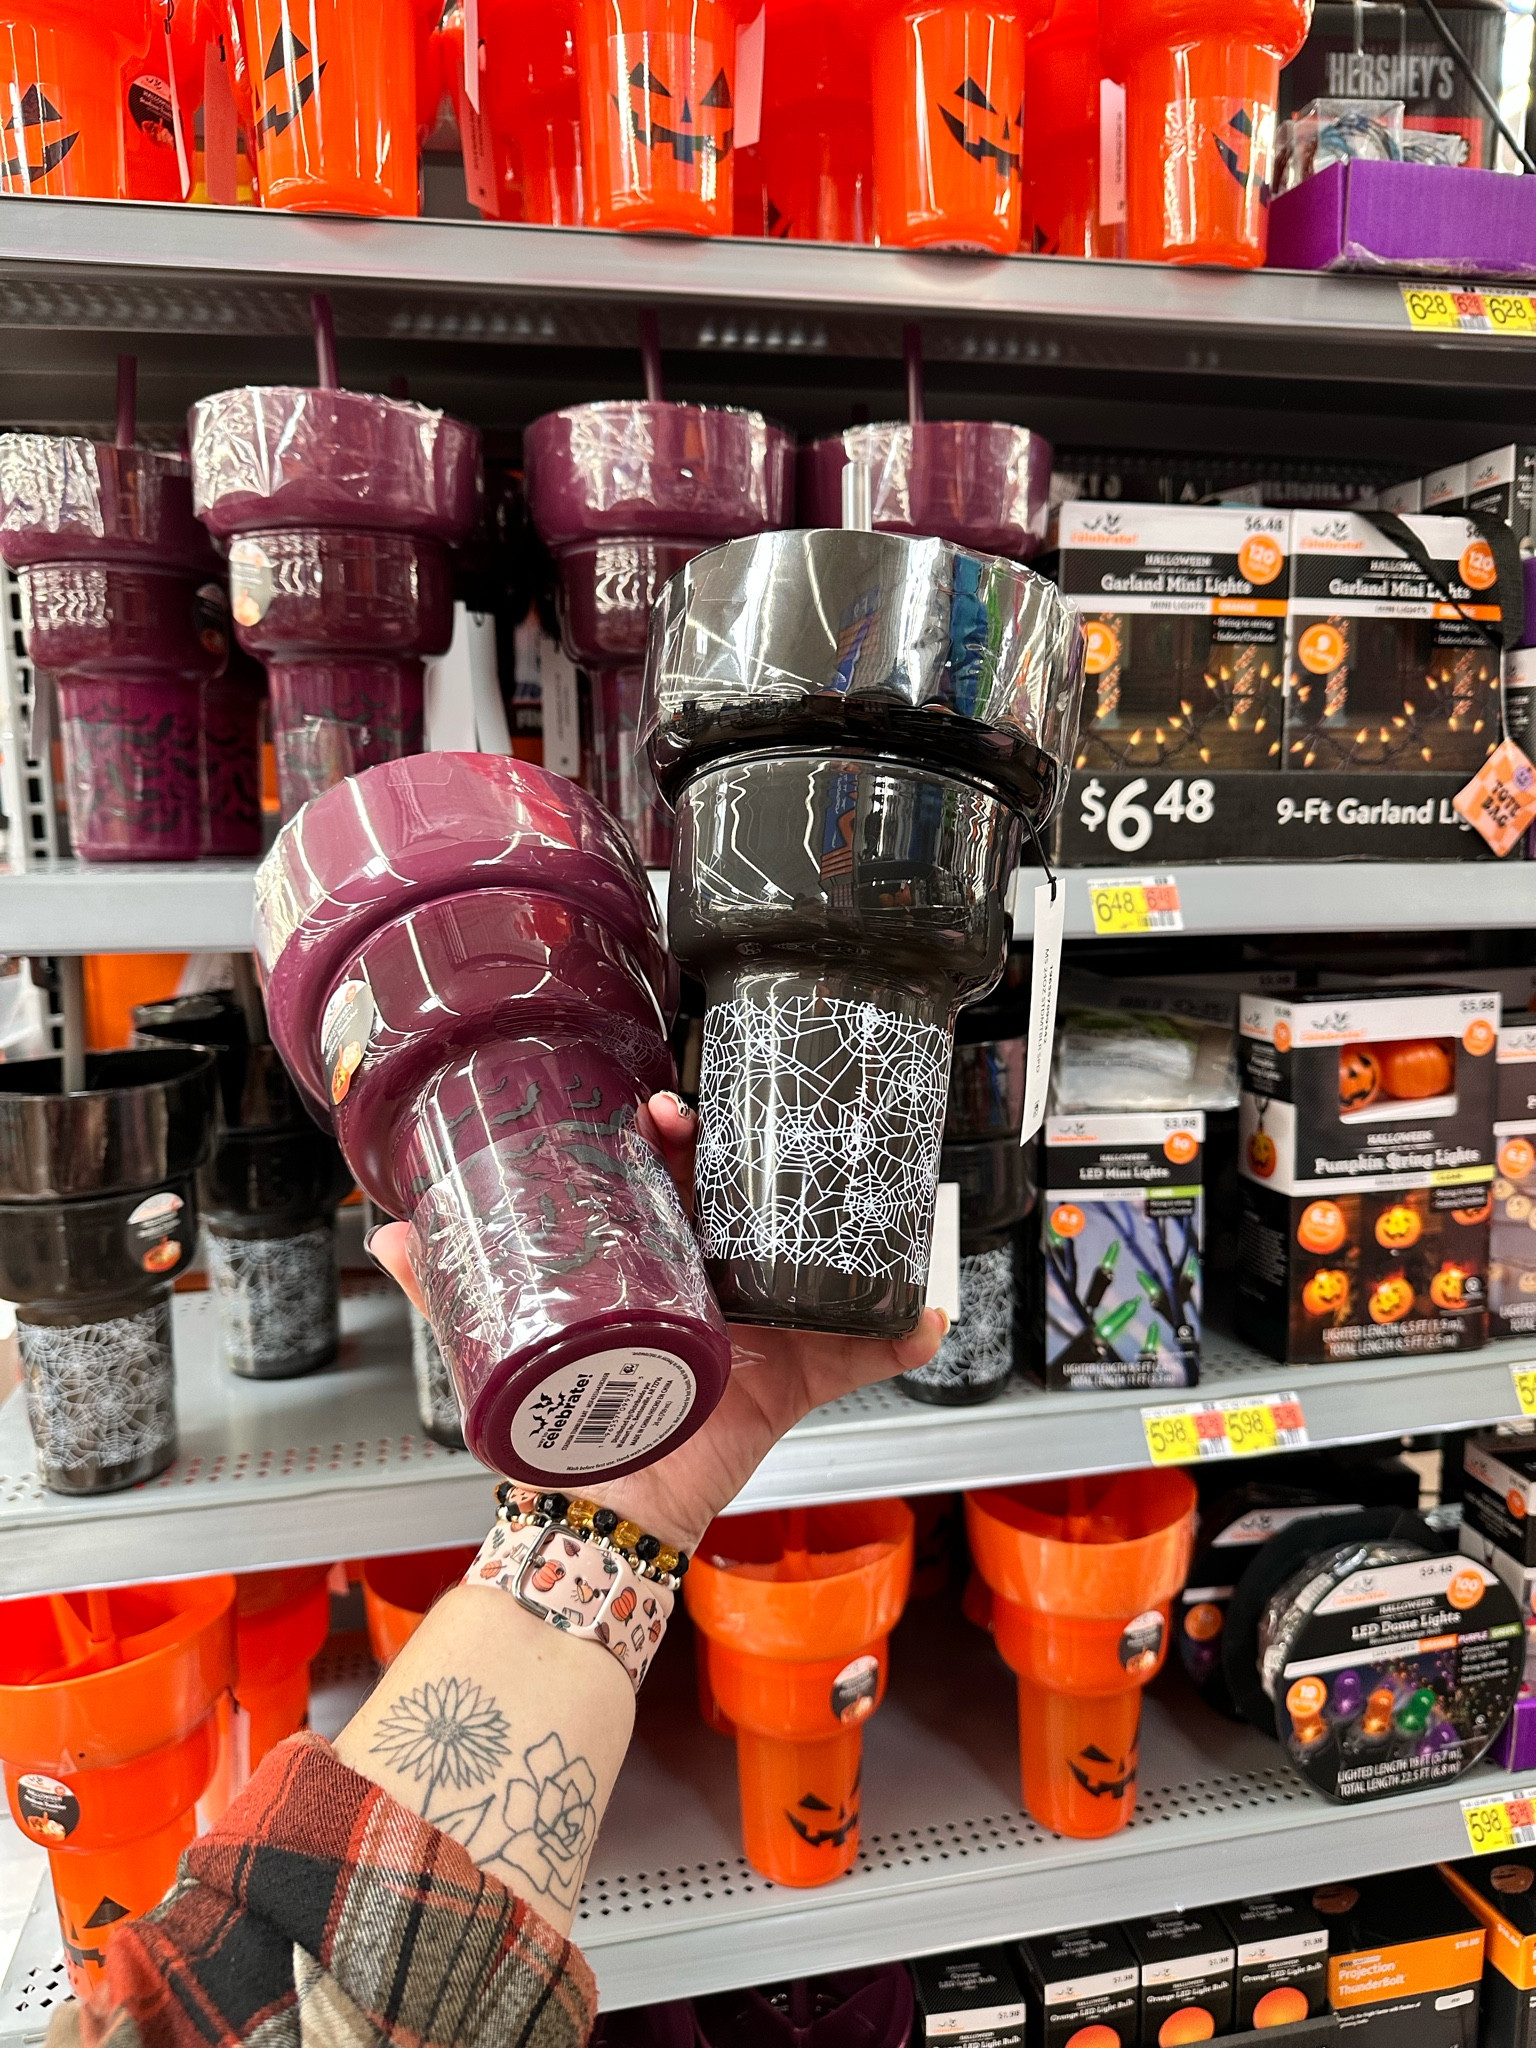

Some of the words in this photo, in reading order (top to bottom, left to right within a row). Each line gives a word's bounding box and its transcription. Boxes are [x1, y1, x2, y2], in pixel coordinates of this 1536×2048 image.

[1329, 52, 1455, 99] HERSHEY'S
[1410, 294, 1447, 320] 628
[1490, 298, 1527, 324] 628
[1101, 573, 1165, 591] Garland
[1167, 575, 1203, 593] Mini
[1205, 576, 1252, 596] Lights
[1329, 578, 1389, 596] Garland
[1391, 580, 1424, 597] Mini
[1277, 797, 1334, 825] 9-Ft
[1336, 797, 1436, 825] Garland
[1482, 795, 1508, 828] BAG
[1494, 780, 1522, 818] TOTE
[1095, 891, 1135, 923] 648
[1314, 1153, 1385, 1175] Pumpkin
[1386, 1151, 1435, 1169] String
[1435, 1146, 1481, 1167] Lights
[1079, 1167, 1104, 1180] LED
[1106, 1167, 1132, 1180] Mini
[1133, 1166, 1170, 1181] Lights
[543, 1373, 594, 1449] celebrate!
[1150, 1419, 1187, 1452] 598
[1227, 1409, 1264, 1443] 598
[1455, 1576, 1480, 1591] 100
[1351, 1623, 1381, 1641] LED
[1381, 1617, 1420, 1634] Dome
[1420, 1610, 1462, 1628] Lights
[1459, 1630, 1489, 1644] PURPLE
[1337, 1764, 1374, 1783] LIGHTED
[1374, 1758, 1409, 1777] LENGTH
[1340, 1781, 1367, 1798] TOTAL
[1366, 1774, 1400, 1792] LENGTH
[1470, 1808, 1503, 1843] 598
[1242, 1973, 1270, 1984] Orange
[1270, 1968, 1287, 1978] LED
[1287, 1965, 1307, 1977] Light
[1306, 1961, 1324, 1972] Bulb
[1339, 1961, 1396, 1981] Projection
[1146, 1992, 1176, 2004] Orange
[1175, 1988, 1192, 1998] LED
[1192, 1984, 1212, 1996] Light
[1212, 1980, 1230, 1991] Bulb
[1339, 1973, 1405, 1996] ThunderBolt
[1050, 2012, 1080, 2023] Orange
[1080, 2007, 1097, 2017] LED
[1097, 2002, 1117, 2014] Light
[1117, 1998, 1136, 2009] Bulb
[1002, 2034, 1022, 2045] Bulb
